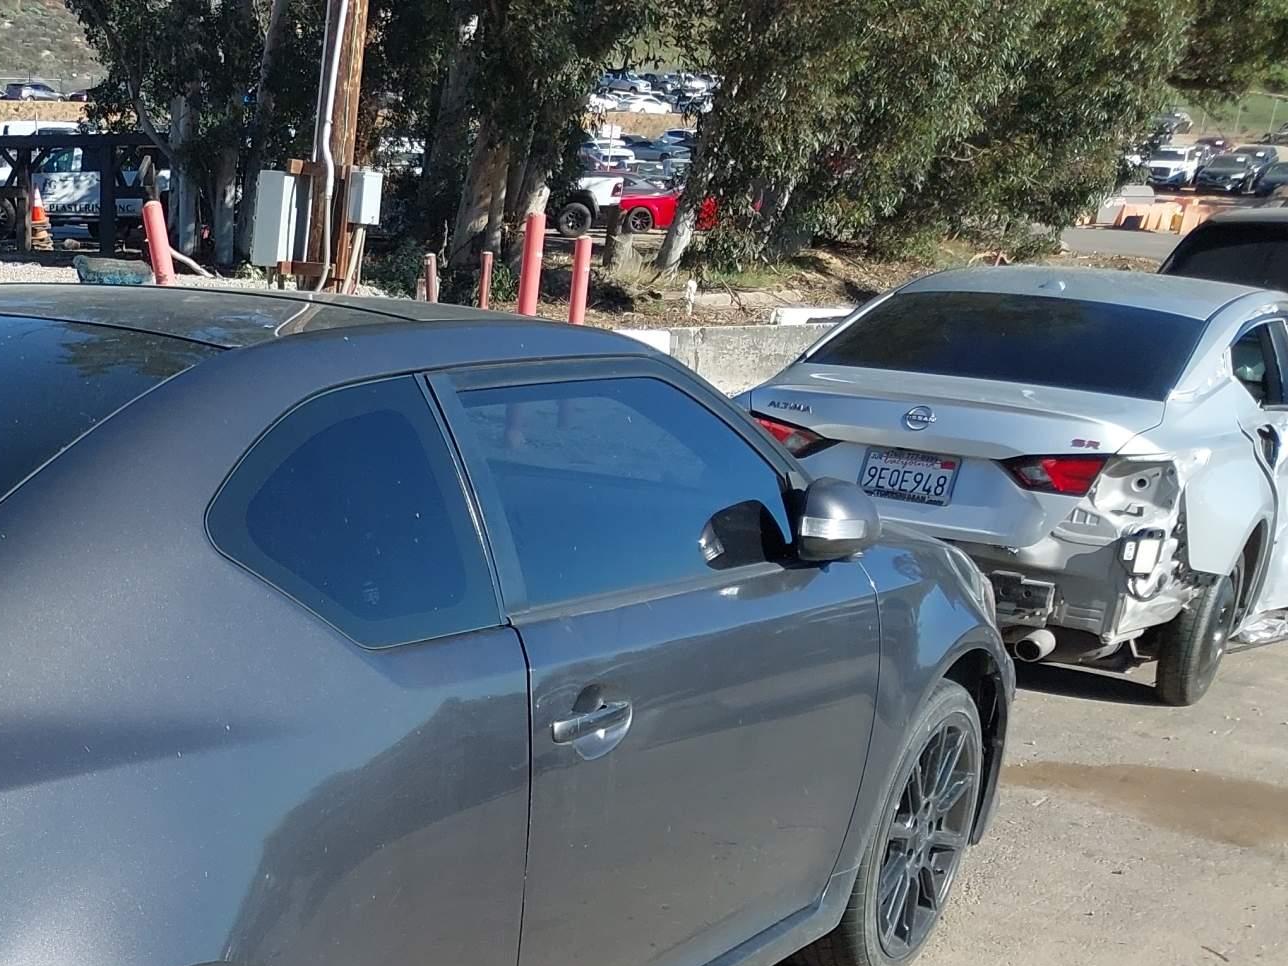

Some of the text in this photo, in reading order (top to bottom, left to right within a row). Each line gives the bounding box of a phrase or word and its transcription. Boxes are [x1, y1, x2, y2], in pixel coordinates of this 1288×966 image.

[49, 203, 101, 213] PLASTERIN
[1070, 438, 1101, 450] SR
[863, 465, 948, 497] 9EQE948
